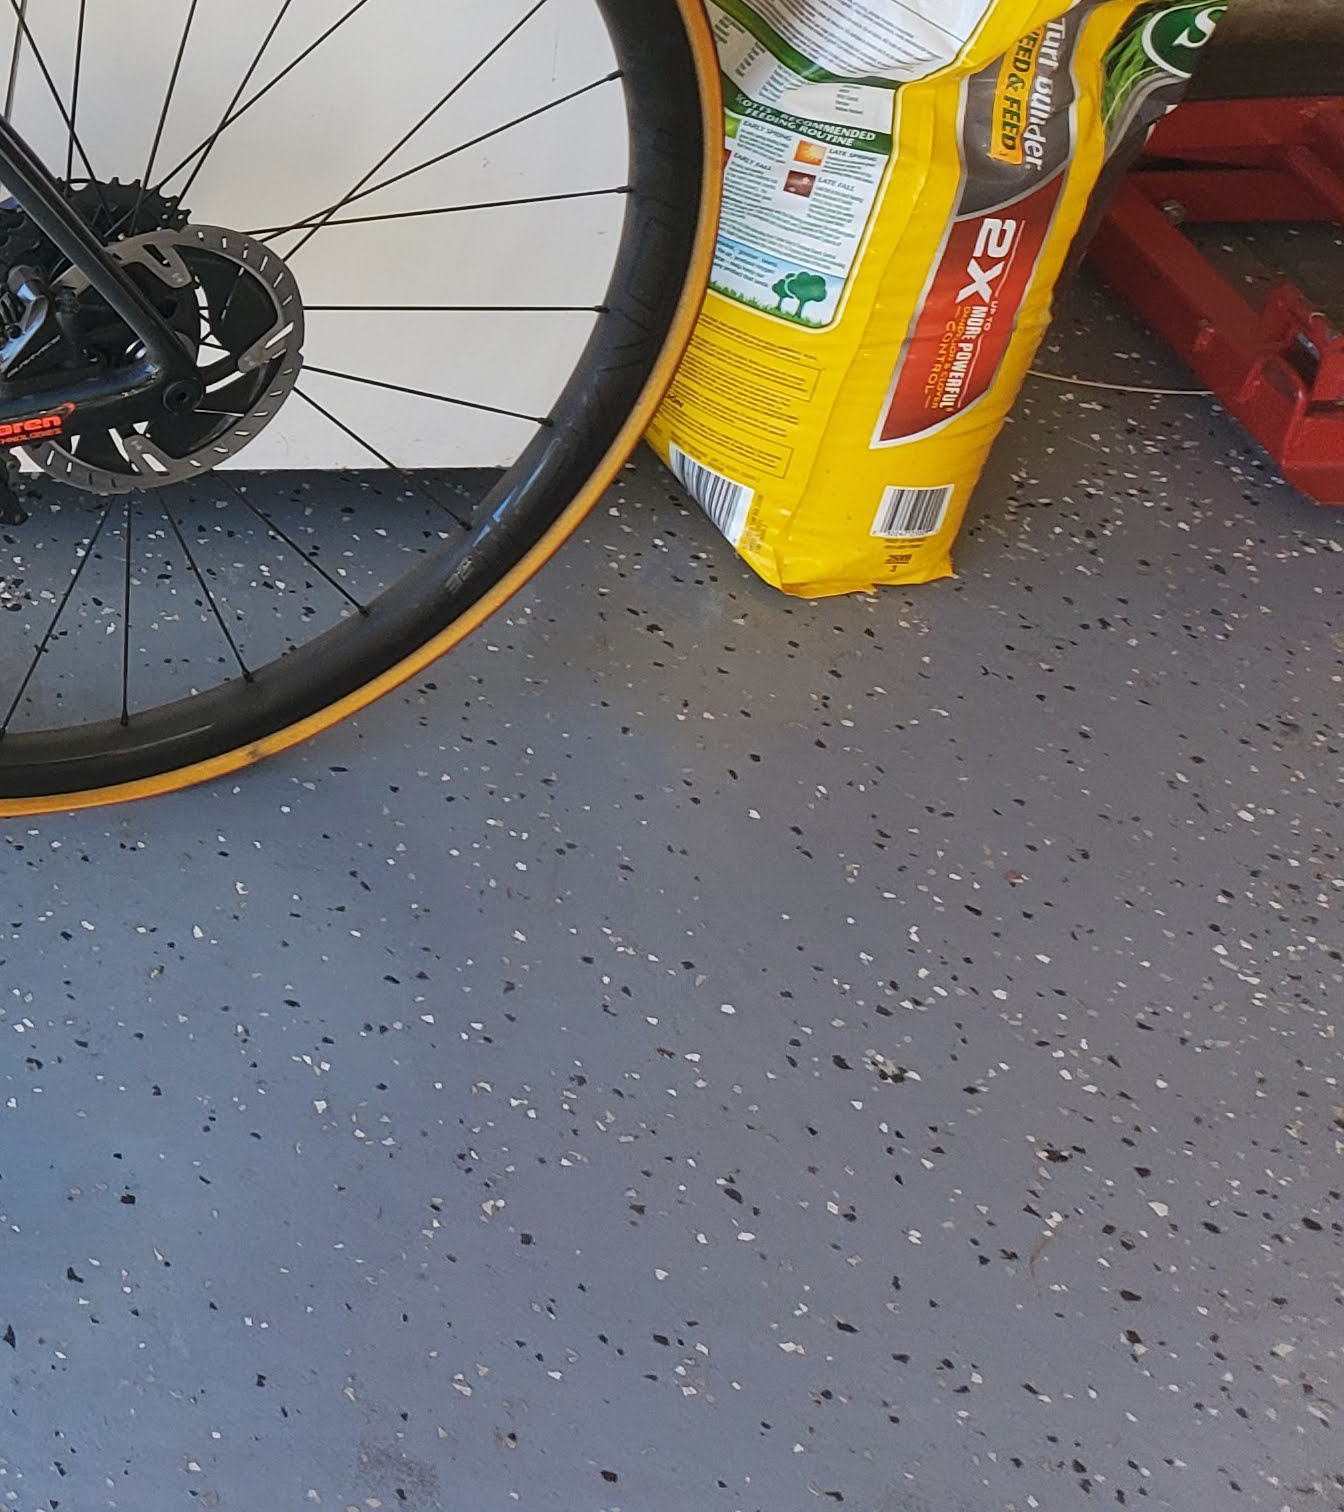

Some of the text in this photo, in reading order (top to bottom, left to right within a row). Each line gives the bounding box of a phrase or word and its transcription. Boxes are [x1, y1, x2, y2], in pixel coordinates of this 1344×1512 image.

[1014, 29, 1044, 74] EED
[744, 107, 797, 130] FEEDING
[798, 124, 856, 147] ROUTINE
[780, 112, 877, 141] RECOMMENDED
[1001, 94, 1024, 151] FEED
[955, 218, 1016, 304] 2X
[925, 321, 956, 394] CONTROL
[939, 305, 989, 409] MORE POWERFUL
